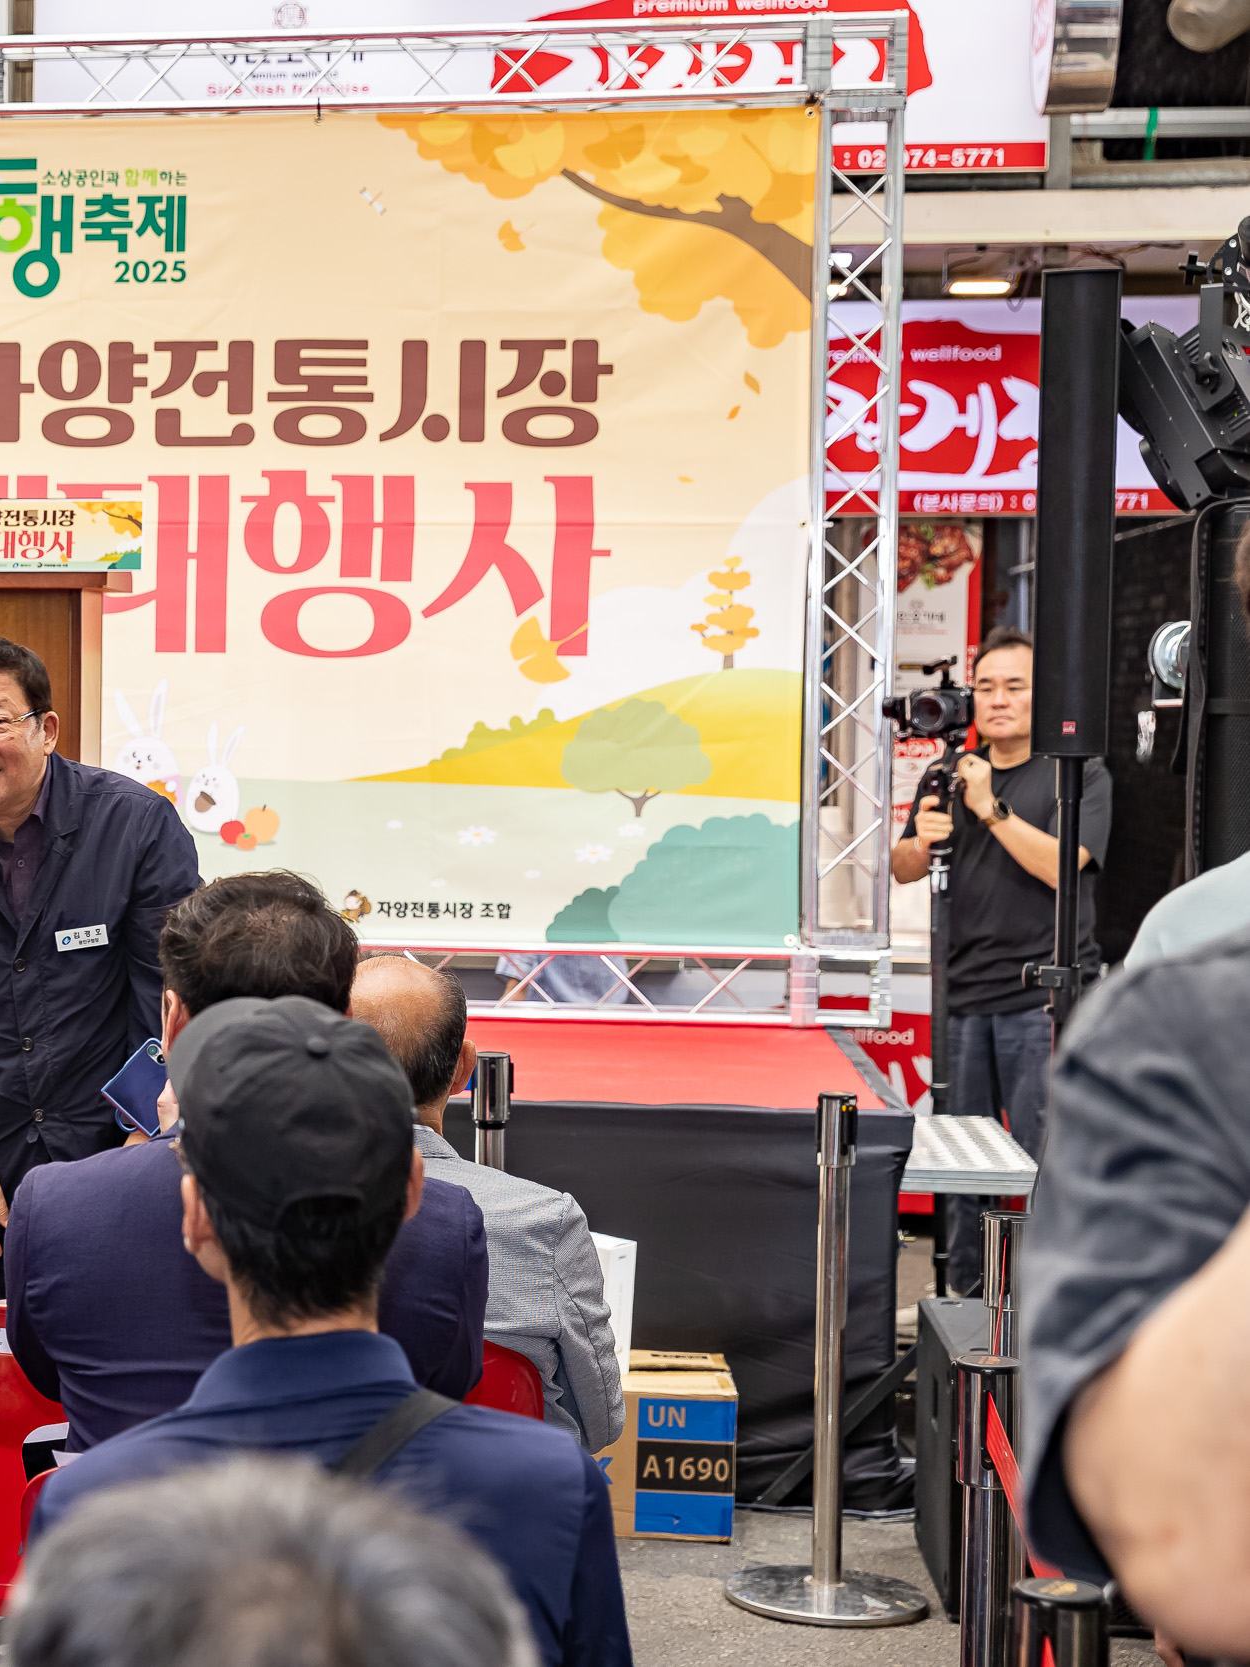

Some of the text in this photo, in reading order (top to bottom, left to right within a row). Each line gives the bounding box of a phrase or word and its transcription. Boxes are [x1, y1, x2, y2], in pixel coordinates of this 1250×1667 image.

[857, 147, 1005, 169] 0274-5771
[41, 168, 187, 188] 소상공인과 함께하는
[114, 260, 187, 284] 2025
[377, 901, 474, 919] 자양전통시장
[647, 1405, 687, 1428] UN
[642, 1454, 730, 1482] A1690
